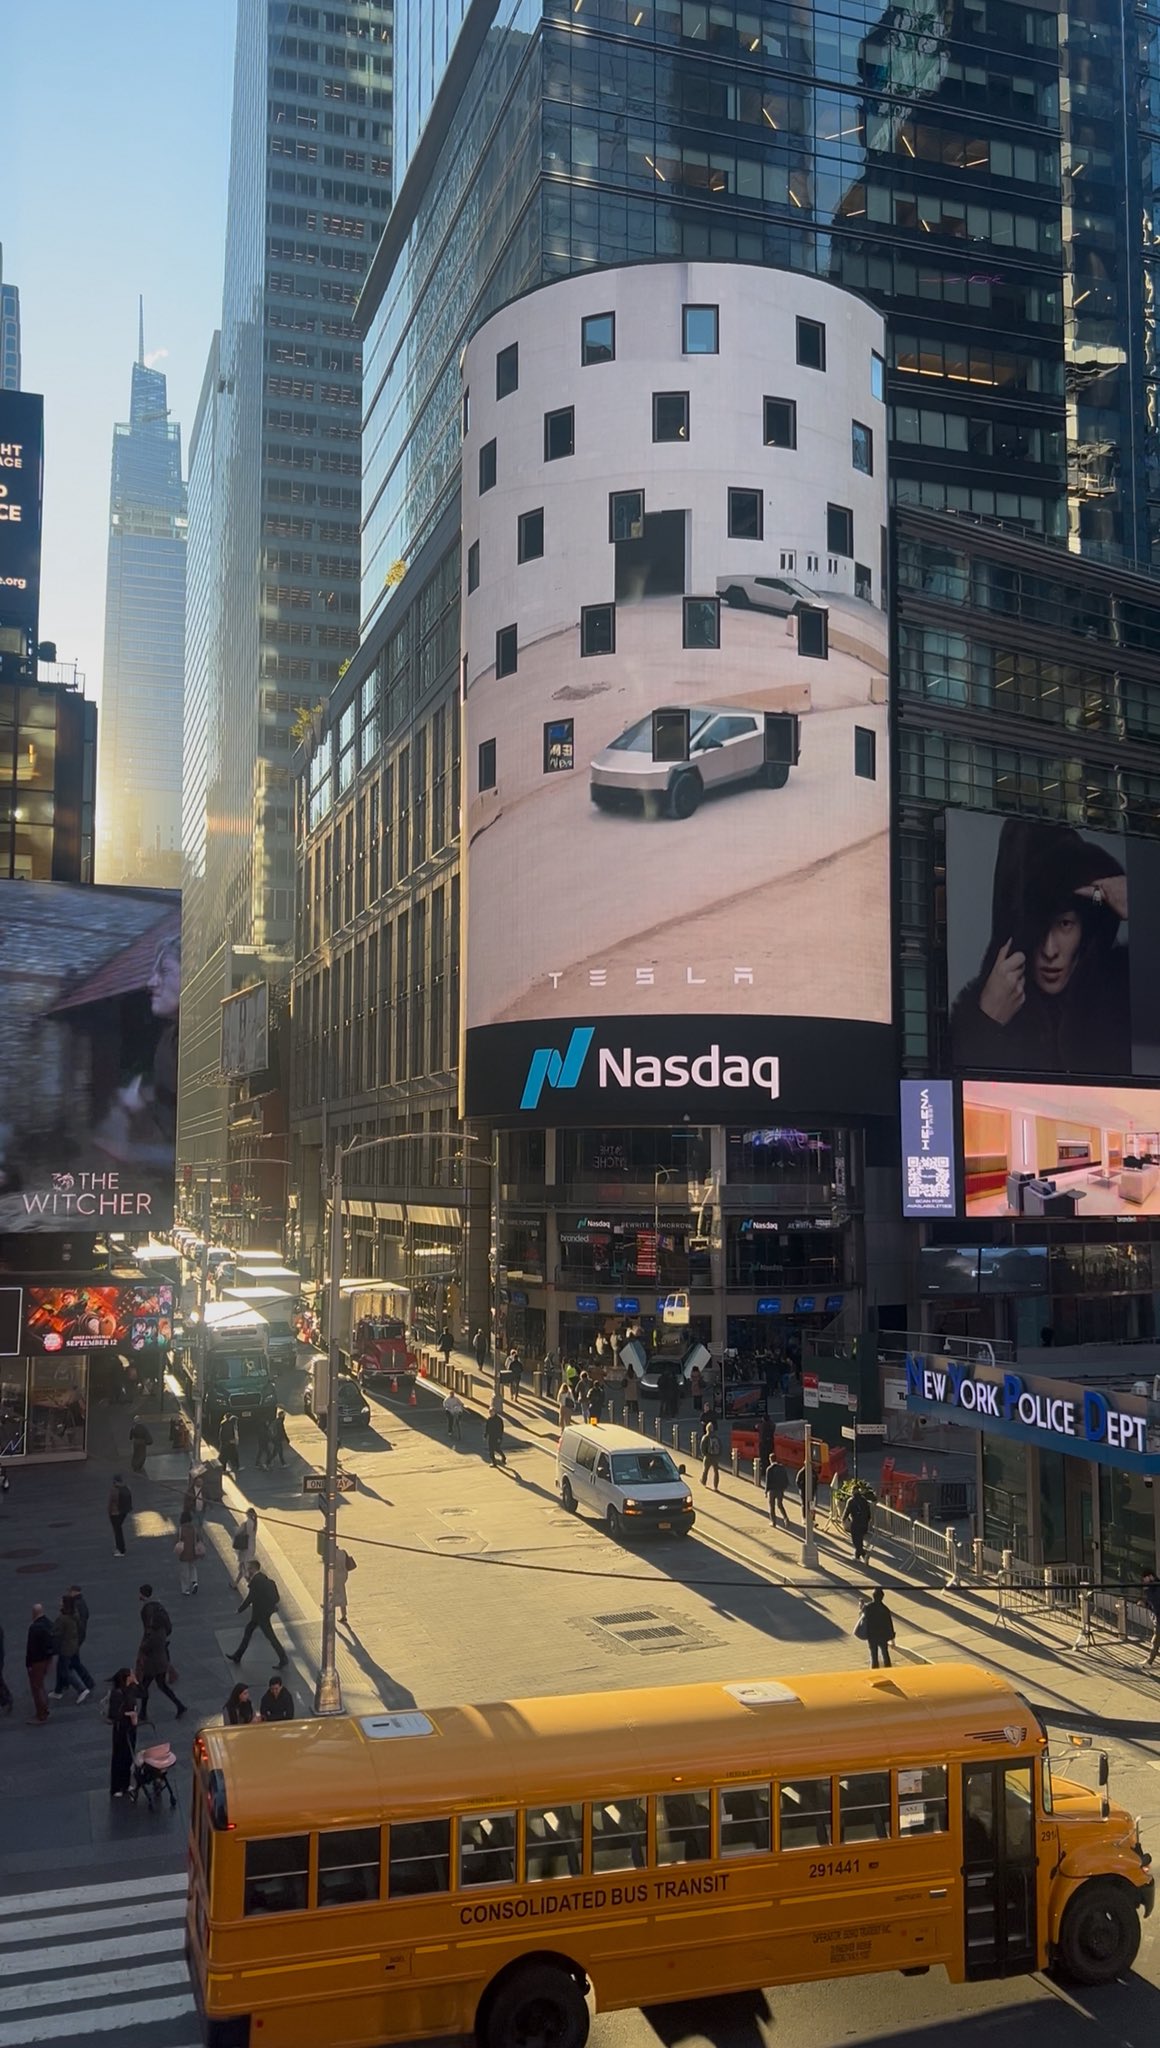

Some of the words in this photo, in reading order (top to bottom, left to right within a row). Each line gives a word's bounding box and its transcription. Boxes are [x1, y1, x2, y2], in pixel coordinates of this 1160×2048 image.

[548, 967, 753, 989] TESLA
[600, 1044, 780, 1100] Nasdaq
[920, 1088, 930, 1150] HELENA
[78, 1173, 119, 1190] THE
[22, 1193, 152, 1216] WITCHER
[587, 1219, 611, 1229] Nasdaq
[752, 1221, 778, 1231] Nasdaq
[560, 1233, 589, 1243] branded
[66, 1339, 109, 1347] SEPTEMBER
[905, 1353, 946, 1402] NEW
[947, 1361, 999, 1417] YORK
[1003, 1372, 1075, 1435] POLICE
[1084, 1390, 1147, 1453] DEPT
[809, 1859, 860, 1878] 291441
[460, 1890, 607, 1925] CONSOLIDATED
[611, 1884, 648, 1906] BUS
[654, 1874, 730, 1899] TRANSIT
